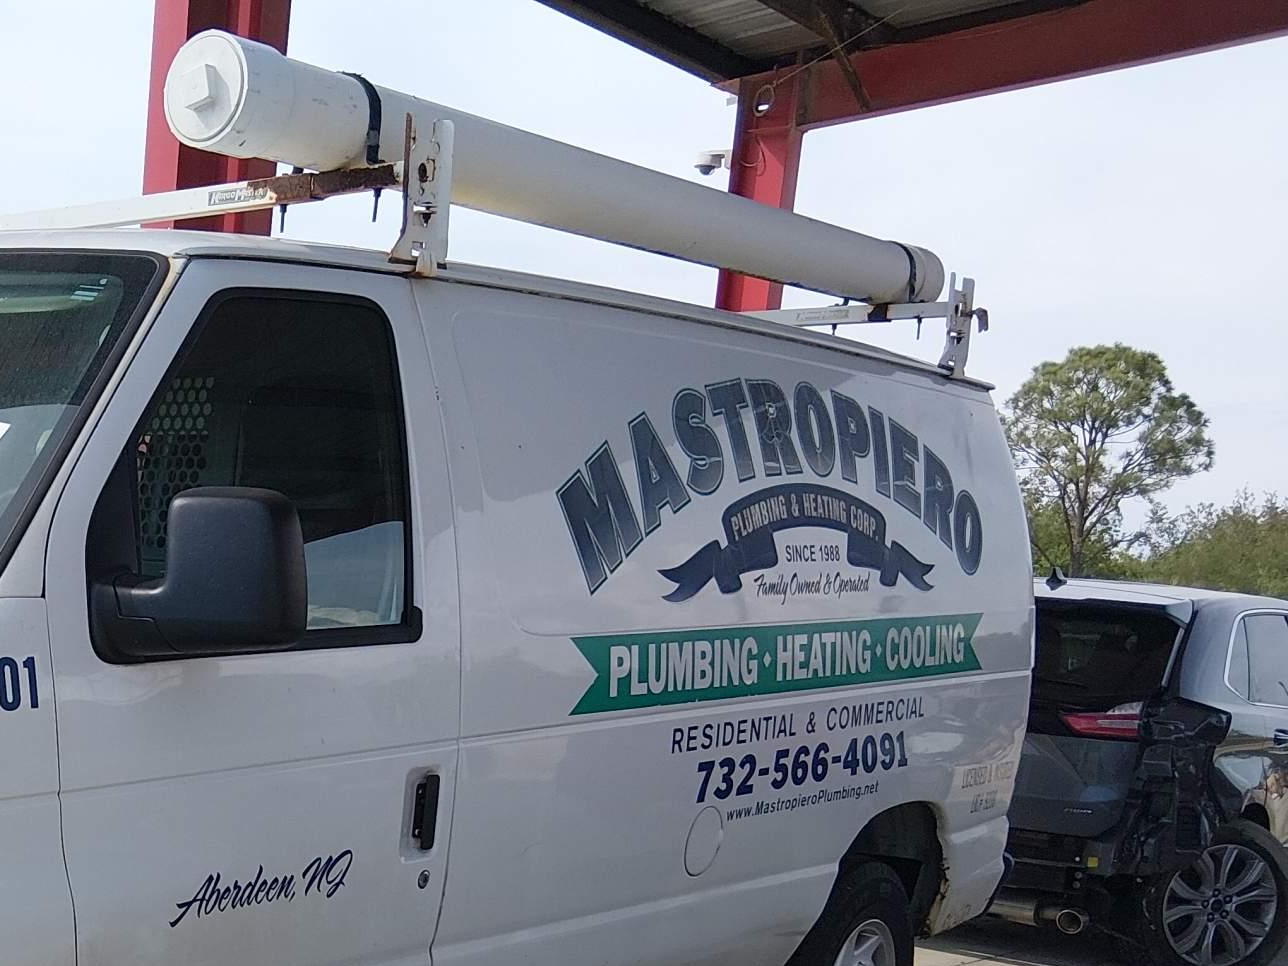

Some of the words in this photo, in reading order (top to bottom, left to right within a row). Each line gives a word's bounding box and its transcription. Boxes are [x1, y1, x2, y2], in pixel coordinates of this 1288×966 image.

[555, 377, 983, 596] MASTROPIERO
[730, 495, 787, 541] PLUMBING
[791, 493, 800, 517] &
[802, 492, 847, 524] HEATING
[850, 505, 879, 542] CORP.
[785, 545, 817, 563] SINCE
[819, 545, 841, 562] 1988
[754, 573, 789, 606] Family
[790, 572, 822, 597] Owned
[823, 574, 833, 596] &
[833, 571, 871, 599] Operated
[609, 636, 759, 697] PLUMBING
[776, 629, 872, 681] HEATING
[885, 623, 965, 671] COOLING
[671, 713, 797, 754] RESIDENTIAL
[806, 711, 816, 734] &
[826, 695, 925, 731] COMMERCIAL
[696, 730, 908, 803] 732-566-4091
[726, 780, 879, 822] www.MastropieroPlumbing.net
[169, 864, 297, 927] Aberdeen,
[302, 849, 353, 898] NJ
